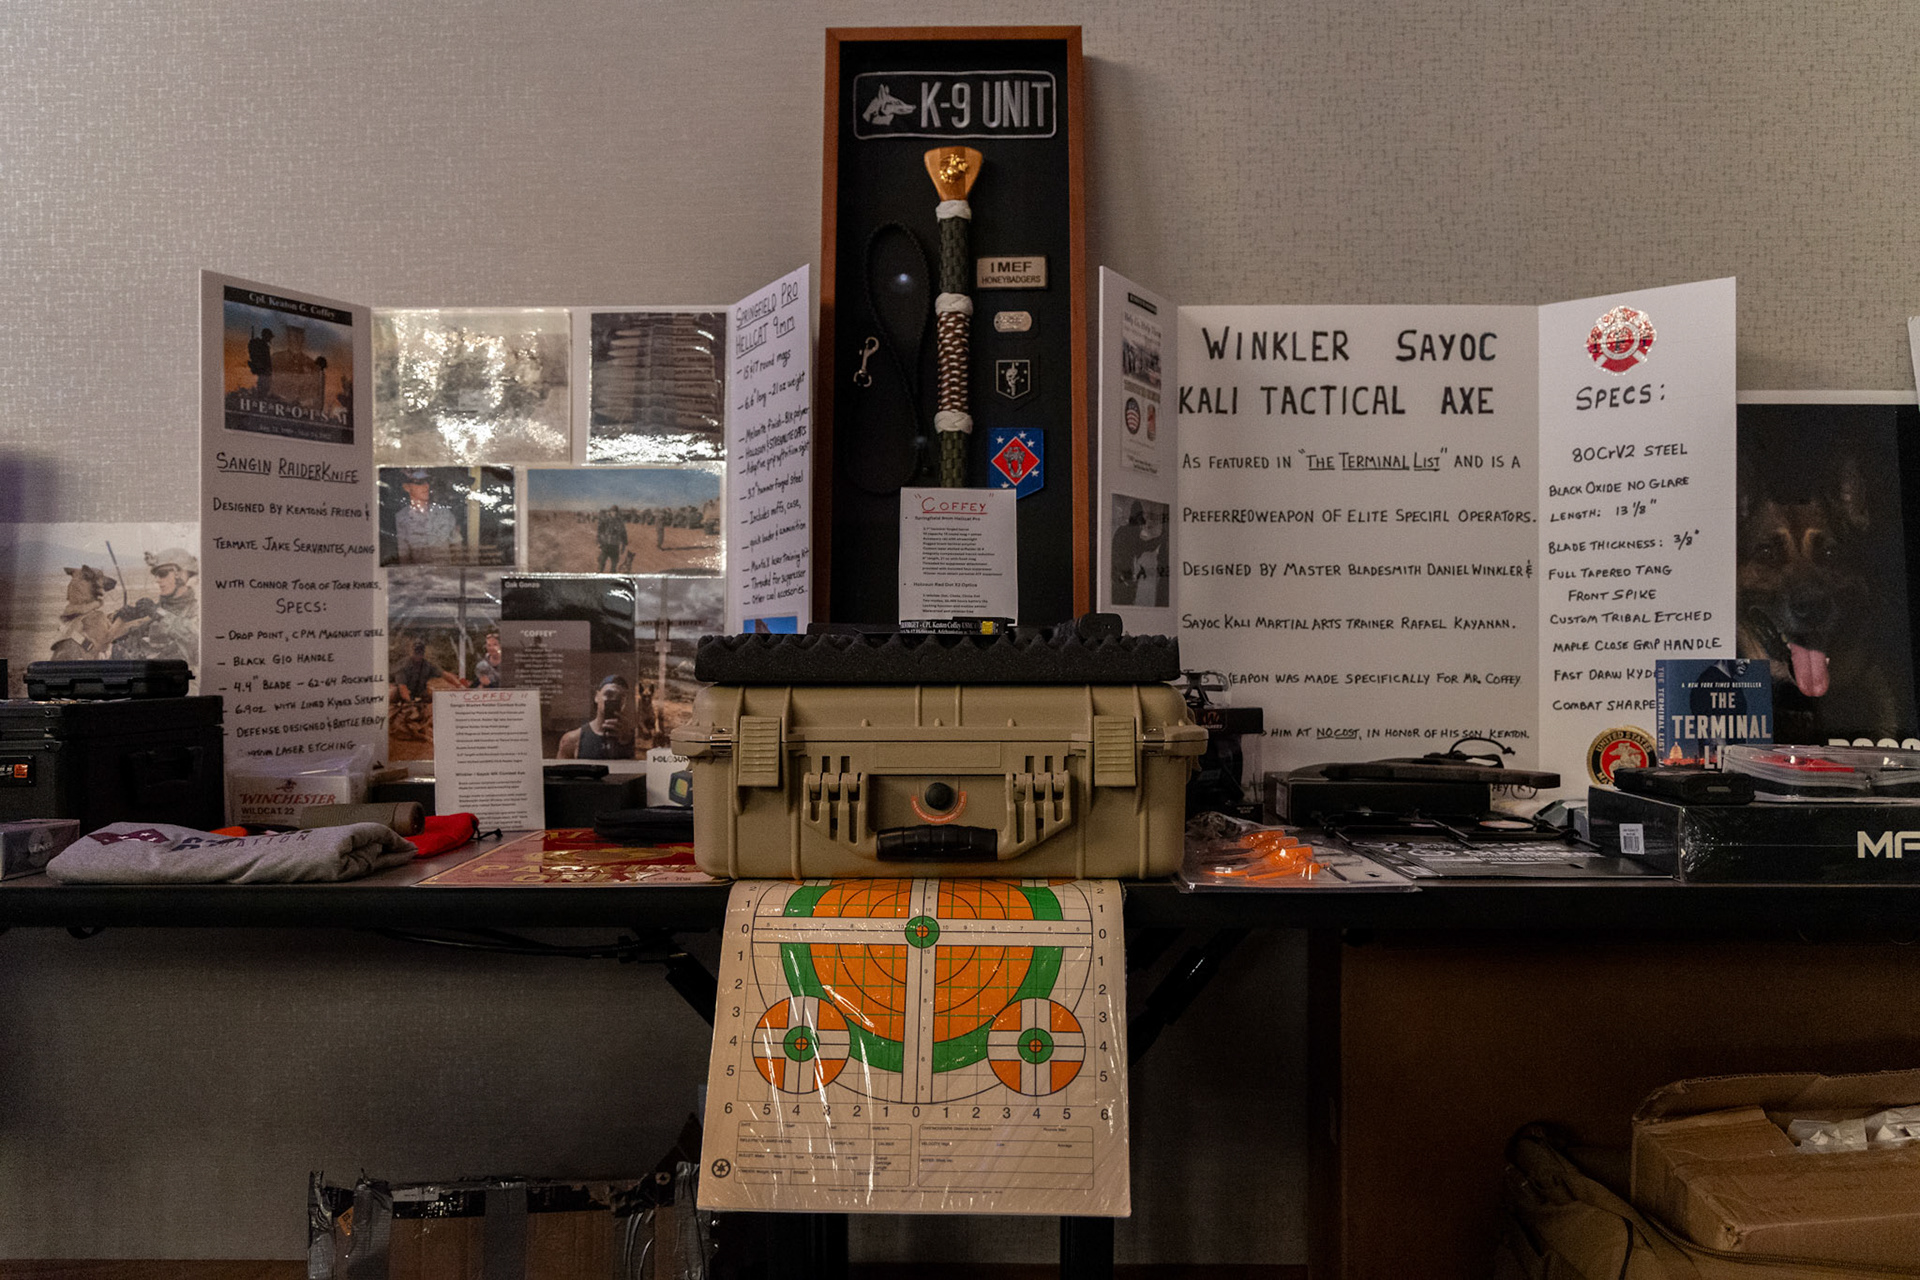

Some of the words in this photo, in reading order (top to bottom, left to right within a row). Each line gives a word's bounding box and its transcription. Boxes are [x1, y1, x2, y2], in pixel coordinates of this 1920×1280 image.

[920, 81, 971, 128] K-9
[982, 80, 1051, 128] UNIT
[997, 261, 1033, 273] MEF
[981, 275, 1042, 284] HONEYBADGERS
[268, 297, 298, 310] Keaton
[311, 306, 337, 320] Coffey
[735, 294, 777, 330] SPRINGFIELD
[781, 281, 799, 308] PRO
[735, 322, 769, 357] HELLCAT
[1201, 326, 1350, 362] WINKLER
[1396, 329, 1498, 362] SAYOC
[759, 354, 775, 372] round
[1178, 386, 1238, 415] KALI
[1260, 385, 1406, 415] TACTICAL
[1440, 386, 1495, 415] AXE
[1575, 384, 1665, 411] SPECS:
[1643, 443, 1688, 457] STEEL
[216, 452, 272, 475] SANGIN
[1182, 453, 1201, 469] AS
[1209, 456, 1270, 469] FEATURED
[1277, 456, 1292, 469] IN
[1338, 452, 1410, 471] TERMINAL
[1454, 455, 1483, 469] AND
[1491, 455, 1505, 469] IS
[1511, 455, 1521, 469] A
[790, 470, 804, 486] steel
[1549, 485, 1583, 497] BLACK
[1585, 481, 1622, 494] OXIDE
[1627, 480, 1645, 491] NO
[1649, 476, 1690, 489] GLARE
[213, 497, 265, 514] DESIGNED
[269, 503, 283, 515] BY
[331, 506, 362, 518] FRIEND
[750, 506, 770, 525] Includes
[1322, 508, 1342, 523] OF
[1347, 509, 1388, 523] ELITE
[1395, 508, 1450, 523] SPECIAL
[1458, 509, 1537, 523] OPERATORS.
[1550, 508, 1601, 523] LENGTH:
[213, 537, 258, 550] TEAMATE
[262, 536, 291, 552] JAKE
[1548, 541, 1586, 555] BLADE
[1183, 561, 1252, 577] DESIGNED
[1260, 563, 1277, 578] BY
[1283, 563, 1342, 577] MASTER
[1348, 563, 1422, 577] BLADESMITH
[1427, 562, 1469, 576] DANIEL
[1471, 563, 1523, 577] WINKLER
[1548, 568, 1576, 580] FULL
[1581, 568, 1631, 579] TAPERED
[1636, 565, 1673, 576] TANG
[215, 579, 245, 589] WITH
[250, 578, 288, 590] CONNOR
[291, 579, 316, 590] TOOR
[319, 582, 330, 590] OF
[1568, 589, 1609, 602] FRONT
[1611, 589, 1657, 601] SPIKE
[276, 597, 327, 615] SPECS:
[1182, 614, 1221, 630] SAYOC
[1224, 614, 1251, 630] KALI
[1255, 617, 1309, 630] MARTIAL
[1312, 618, 1342, 631] ARTS
[1346, 618, 1394, 630] TRAINER
[1401, 616, 1447, 630] RAFAEL
[1453, 616, 1516, 631] KAYANAN.
[1549, 614, 1598, 625] CUSTOM
[1601, 611, 1651, 624] TRIBAL
[1654, 610, 1712, 623] ETCHED
[229, 630, 254, 641] DROP
[292, 629, 316, 639] CPM
[1553, 641, 1590, 653] MAPLE
[1594, 640, 1629, 651] CLOSE
[1633, 638, 1661, 651] GRIP
[1663, 637, 1723, 651] HANDLE
[233, 656, 266, 667] BLACK
[297, 653, 335, 664] HANDLE
[1275, 673, 1300, 683] WAS
[1304, 673, 1339, 685] MADE
[1344, 673, 1430, 685] SPECIFICALLY
[1436, 672, 1459, 684] FOR
[1463, 673, 1482, 685] MR.
[1485, 672, 1521, 687] COFFEY
[1553, 669, 1583, 682] FAST
[1589, 669, 1622, 681] DRAW
[262, 679, 291, 691] BLADE
[274, 702, 296, 712] WITH
[1552, 699, 1603, 711] COMBAT
[1710, 692, 1736, 709] THE
[236, 727, 280, 739] DEFENSE
[282, 722, 327, 734] DESIGNED
[1271, 728, 1292, 738] HIM
[1296, 727, 1312, 738] AT
[1367, 728, 1380, 738] IN
[1385, 728, 1420, 739] HONOR
[1424, 729, 1438, 738] OF
[1440, 728, 1459, 739] HIS
[1462, 729, 1483, 739] SON
[1489, 728, 1530, 740] KEATON.
[1671, 715, 1772, 739] TERMINAL
[275, 744, 304, 757] LASER
[308, 740, 357, 752] ETCHING
[1596, 732, 1624, 752] UNITED
[1625, 732, 1652, 753] STATES
[239, 793, 336, 806] WINCHESTER
[240, 807, 282, 816] WILDCAT
[284, 807, 295, 815] 22
[724, 1103, 733, 1115] 6
[763, 1104, 771, 1115] 5
[792, 1104, 800, 1115] 4
[853, 1105, 861, 1117] 2
[883, 1106, 889, 1117] 1
[912, 1106, 920, 1117] 0
[943, 1107, 949, 1118] 1
[972, 1107, 980, 1119] 2
[1002, 1107, 1011, 1119] 3
[1032, 1108, 1041, 1119] 4
[1063, 1108, 1071, 1119] 5
